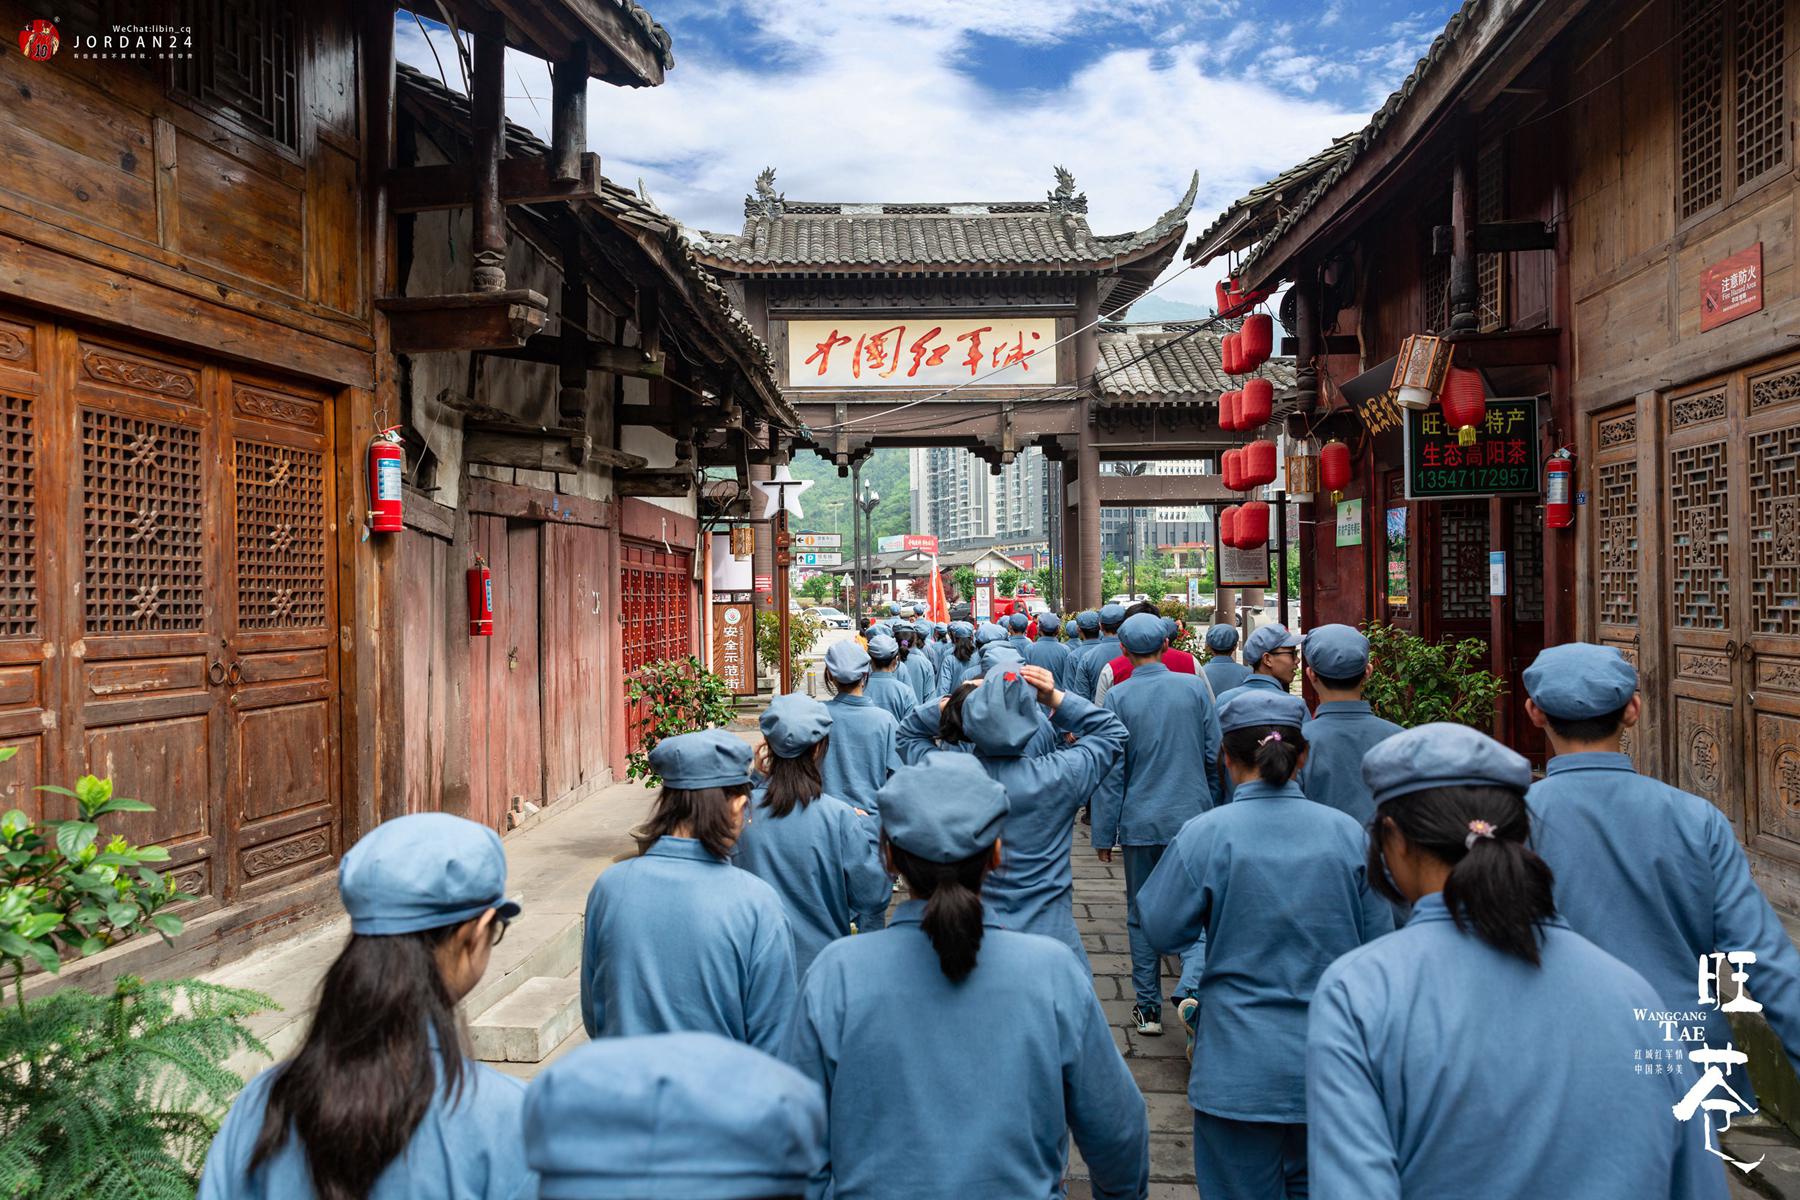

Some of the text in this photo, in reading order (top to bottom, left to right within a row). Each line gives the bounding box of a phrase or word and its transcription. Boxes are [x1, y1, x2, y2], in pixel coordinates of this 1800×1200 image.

[1721, 265, 1757, 293] 注意防火
[1422, 408, 1526, 436] 旺特产
[1422, 439, 1527, 468] 生态高阳茶
[1417, 468, 1529, 489] 13547172957
[723, 626, 739, 689] 安全示范街
